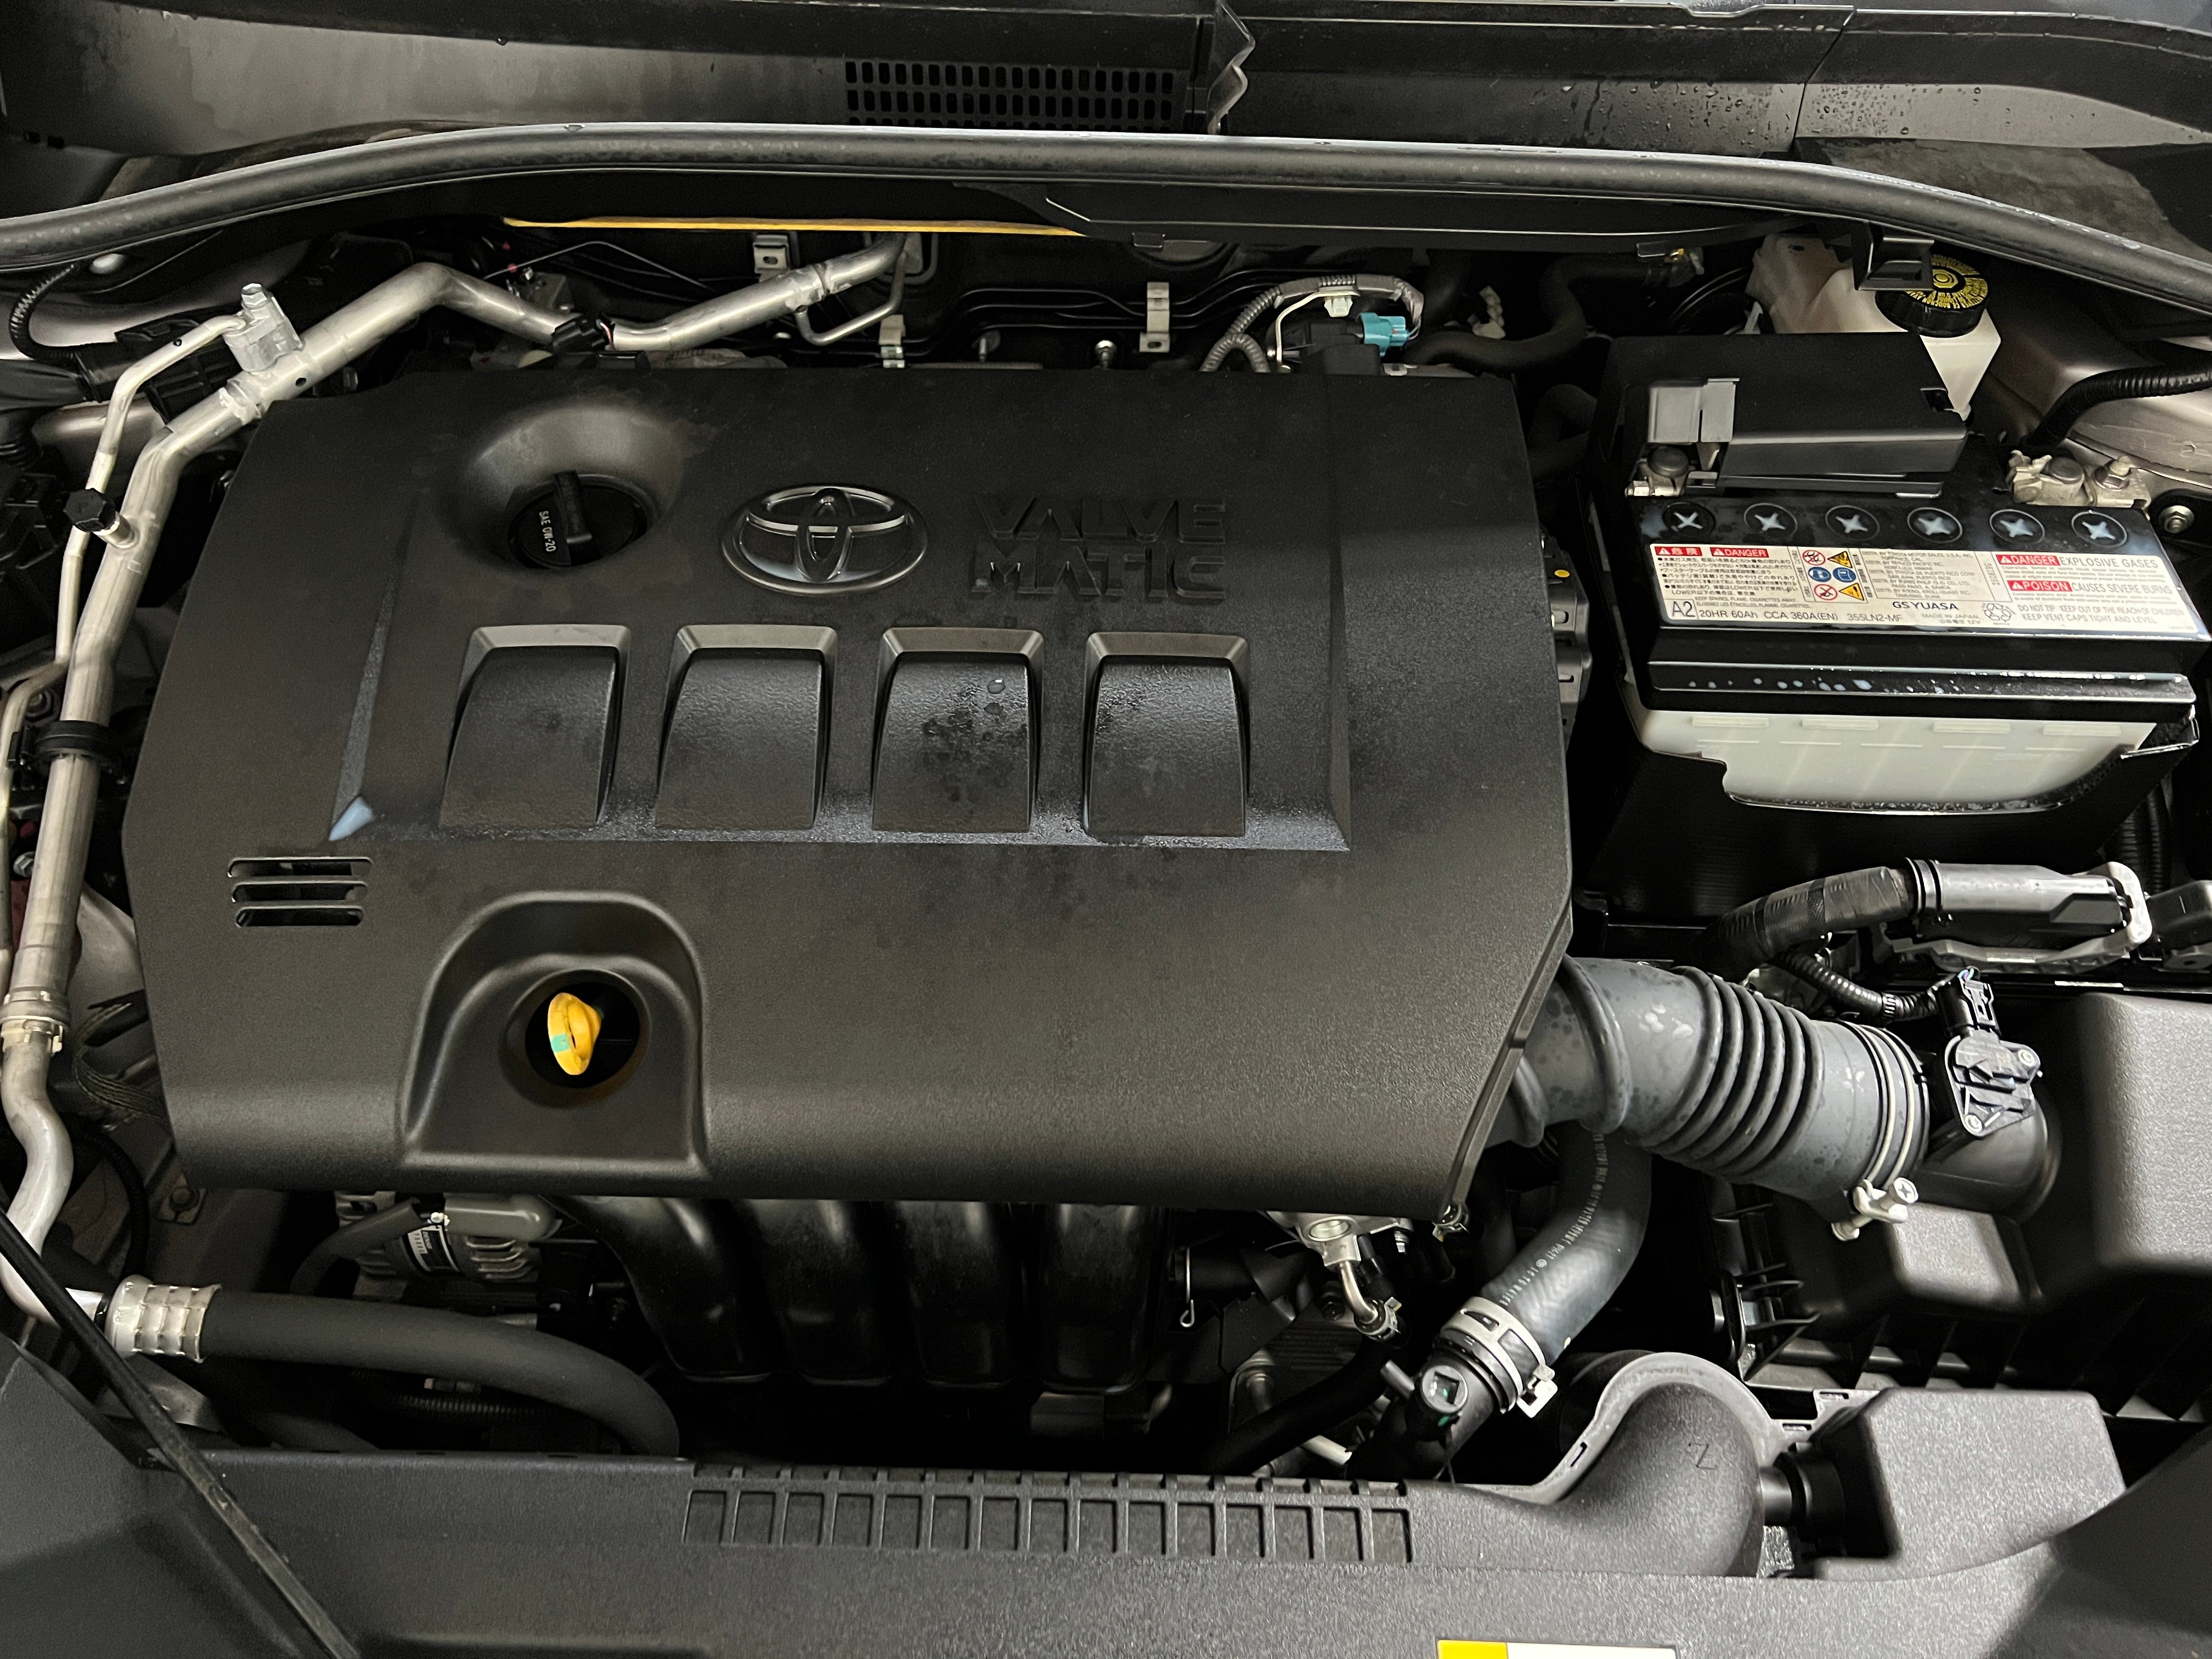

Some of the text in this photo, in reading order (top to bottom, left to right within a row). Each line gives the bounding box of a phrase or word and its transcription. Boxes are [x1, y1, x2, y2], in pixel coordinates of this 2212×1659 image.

[539, 511, 551, 526] SAE
[973, 494, 1226, 544] VALVE
[2010, 555, 2058, 565] DANGER
[2058, 557, 2159, 567] EXPLOSIVE GASES
[971, 544, 1226, 600] MATIC
[2022, 582, 2069, 590] POISON
[2071, 583, 2172, 593] CAUSES SEVERE BURNS
[1671, 601, 1696, 617] A2
[1731, 610, 1757, 618] 60Ah
[1790, 612, 1838, 620] 360A(EN)
[1846, 613, 1903, 622] 355LN2-MF
